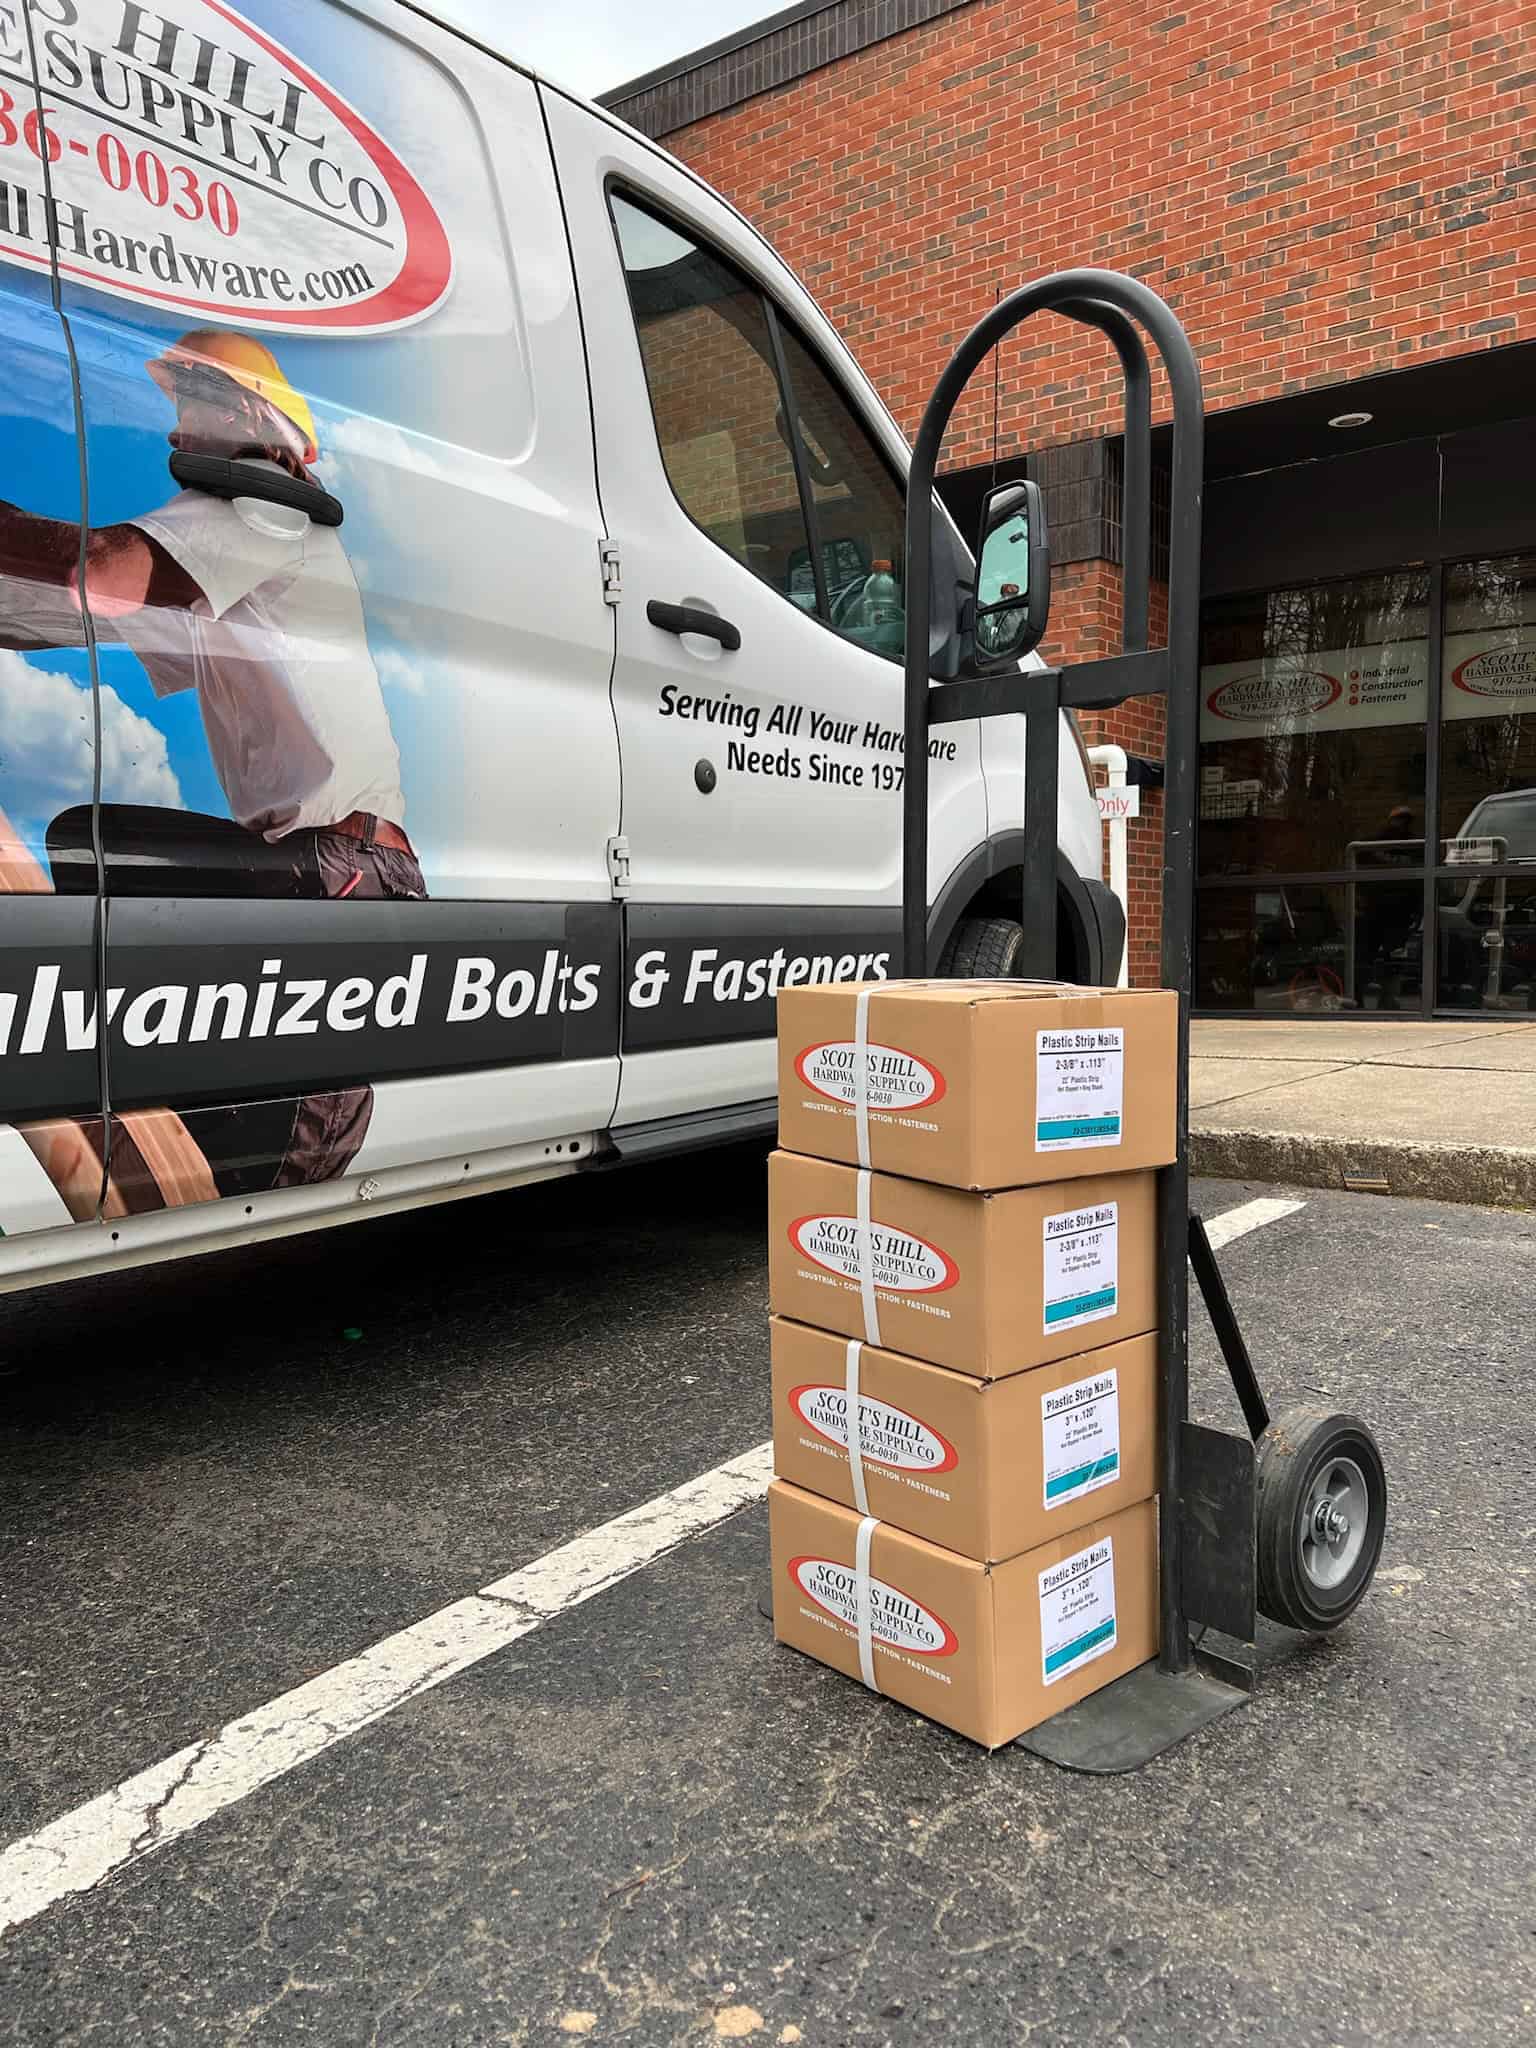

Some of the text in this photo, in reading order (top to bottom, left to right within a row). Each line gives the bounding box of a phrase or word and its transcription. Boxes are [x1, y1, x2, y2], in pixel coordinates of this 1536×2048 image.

[112, 0, 325, 149] HILL
[44, 30, 290, 185] SUPPLY
[309, 158, 388, 228] CO
[1361, 679, 1423, 691] Construction
[1362, 665, 1410, 679] Industrial
[1361, 692, 1407, 704] Fasteners
[659, 684, 957, 760] Serving All Your Harare
[727, 741, 801, 778] Needs
[809, 754, 863, 787] Since
[446, 950, 601, 1022] Bolts
[628, 950, 670, 1008] &
[683, 948, 890, 1004] Fasteners
[1042, 1033, 1119, 1048] Plastic Strip Nails
[813, 1067, 925, 1094] HARDWA SUPPLY CO
[820, 1049, 917, 1078] SCOT'S HILL
[898, 1117, 939, 1132] FASTENERS
[817, 1221, 926, 1262] SCOT'S HILL
[1047, 1209, 1113, 1234] Plastic Strip Nails
[809, 1238, 936, 1280] HARDWA SUPPLY CO
[906, 1298, 951, 1319] FASTENERS
[1046, 1378, 1113, 1412] Plastic Strip Nails
[809, 1406, 935, 1462] HARDWRE SUPPLY CO
[817, 1391, 924, 1443] SCOT'S HILL
[906, 1478, 951, 1502] FASTENERS
[1043, 1547, 1108, 1590] Plastic Strip Nails
[809, 1578, 935, 1644] HARDWA SUPPLY CO
[817, 1565, 924, 1625] SCOTS HILL
